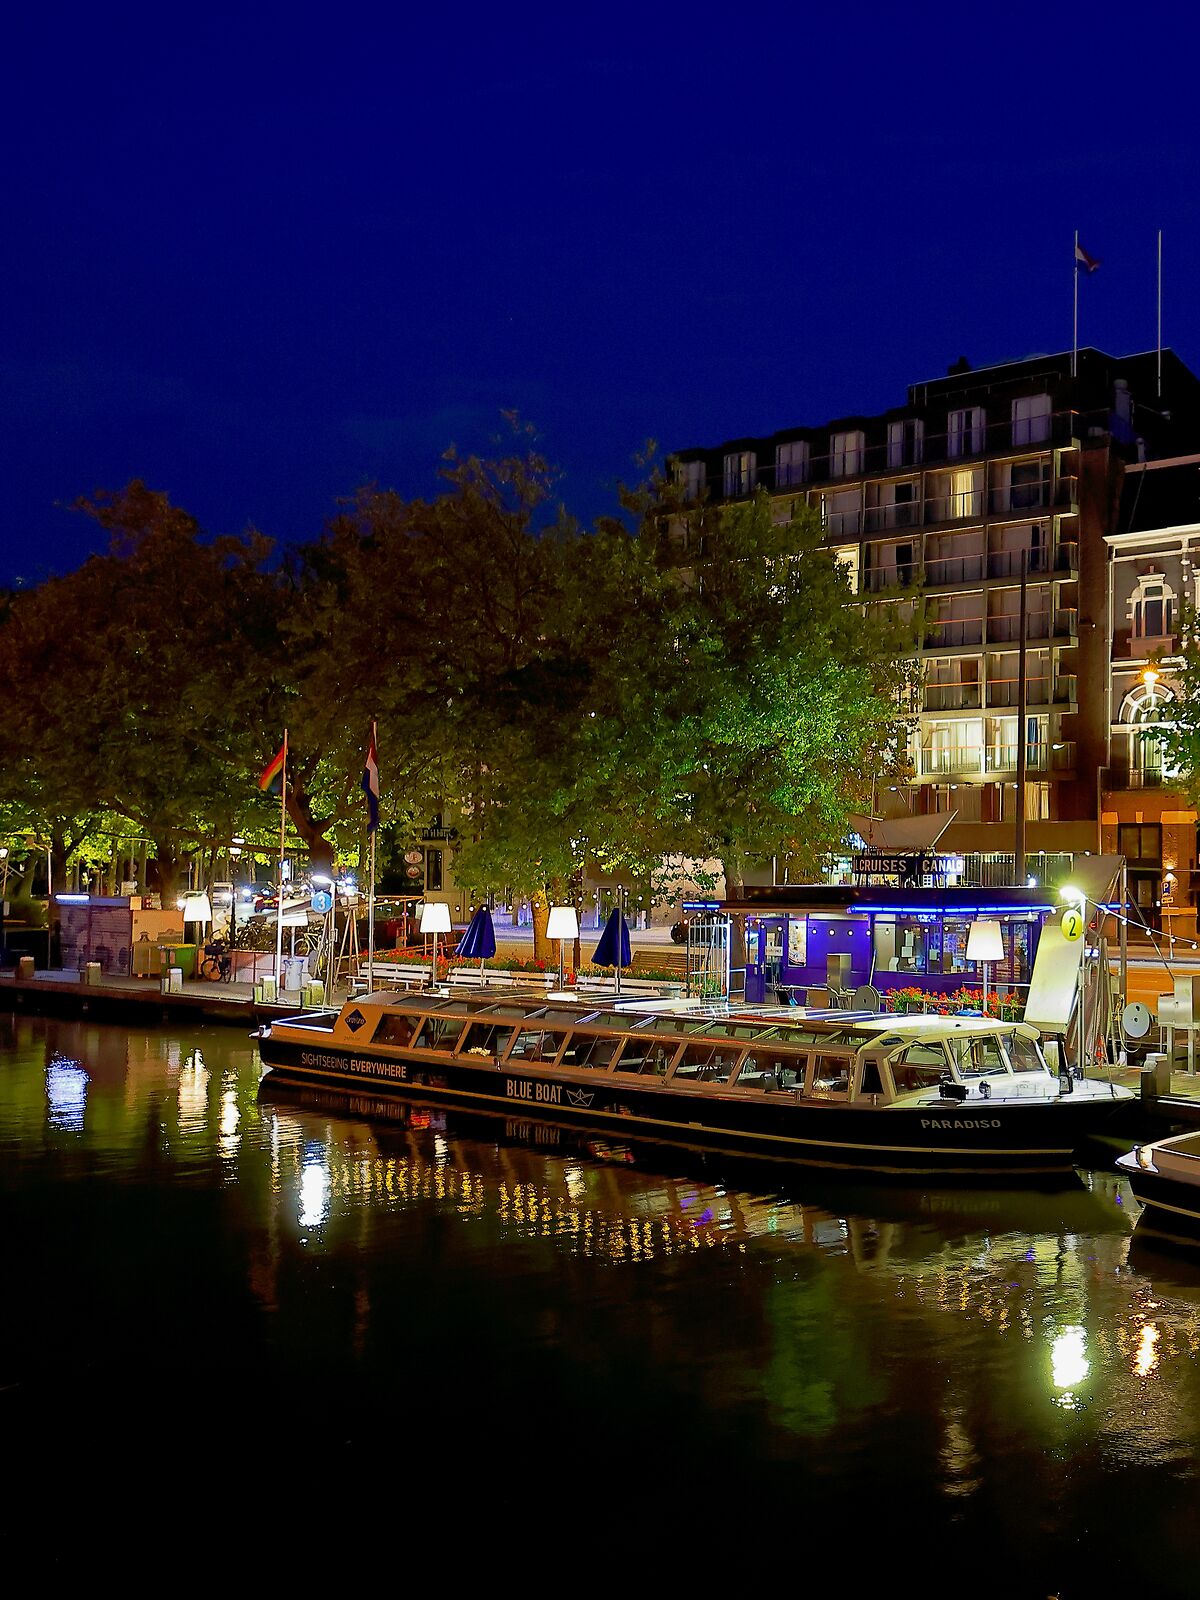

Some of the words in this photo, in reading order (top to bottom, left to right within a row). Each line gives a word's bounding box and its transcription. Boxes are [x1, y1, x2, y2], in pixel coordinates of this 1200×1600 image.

[860, 860, 907, 872] CRUISES
[318, 895, 326, 910] 3
[1069, 916, 1077, 937] 2
[301, 1052, 349, 1071] SIGHTSEEING
[350, 1059, 407, 1078] EVERYWHERE
[506, 1079, 533, 1099] BLUE
[535, 1083, 563, 1103] BOAT
[920, 1119, 1001, 1129] PARADISO
